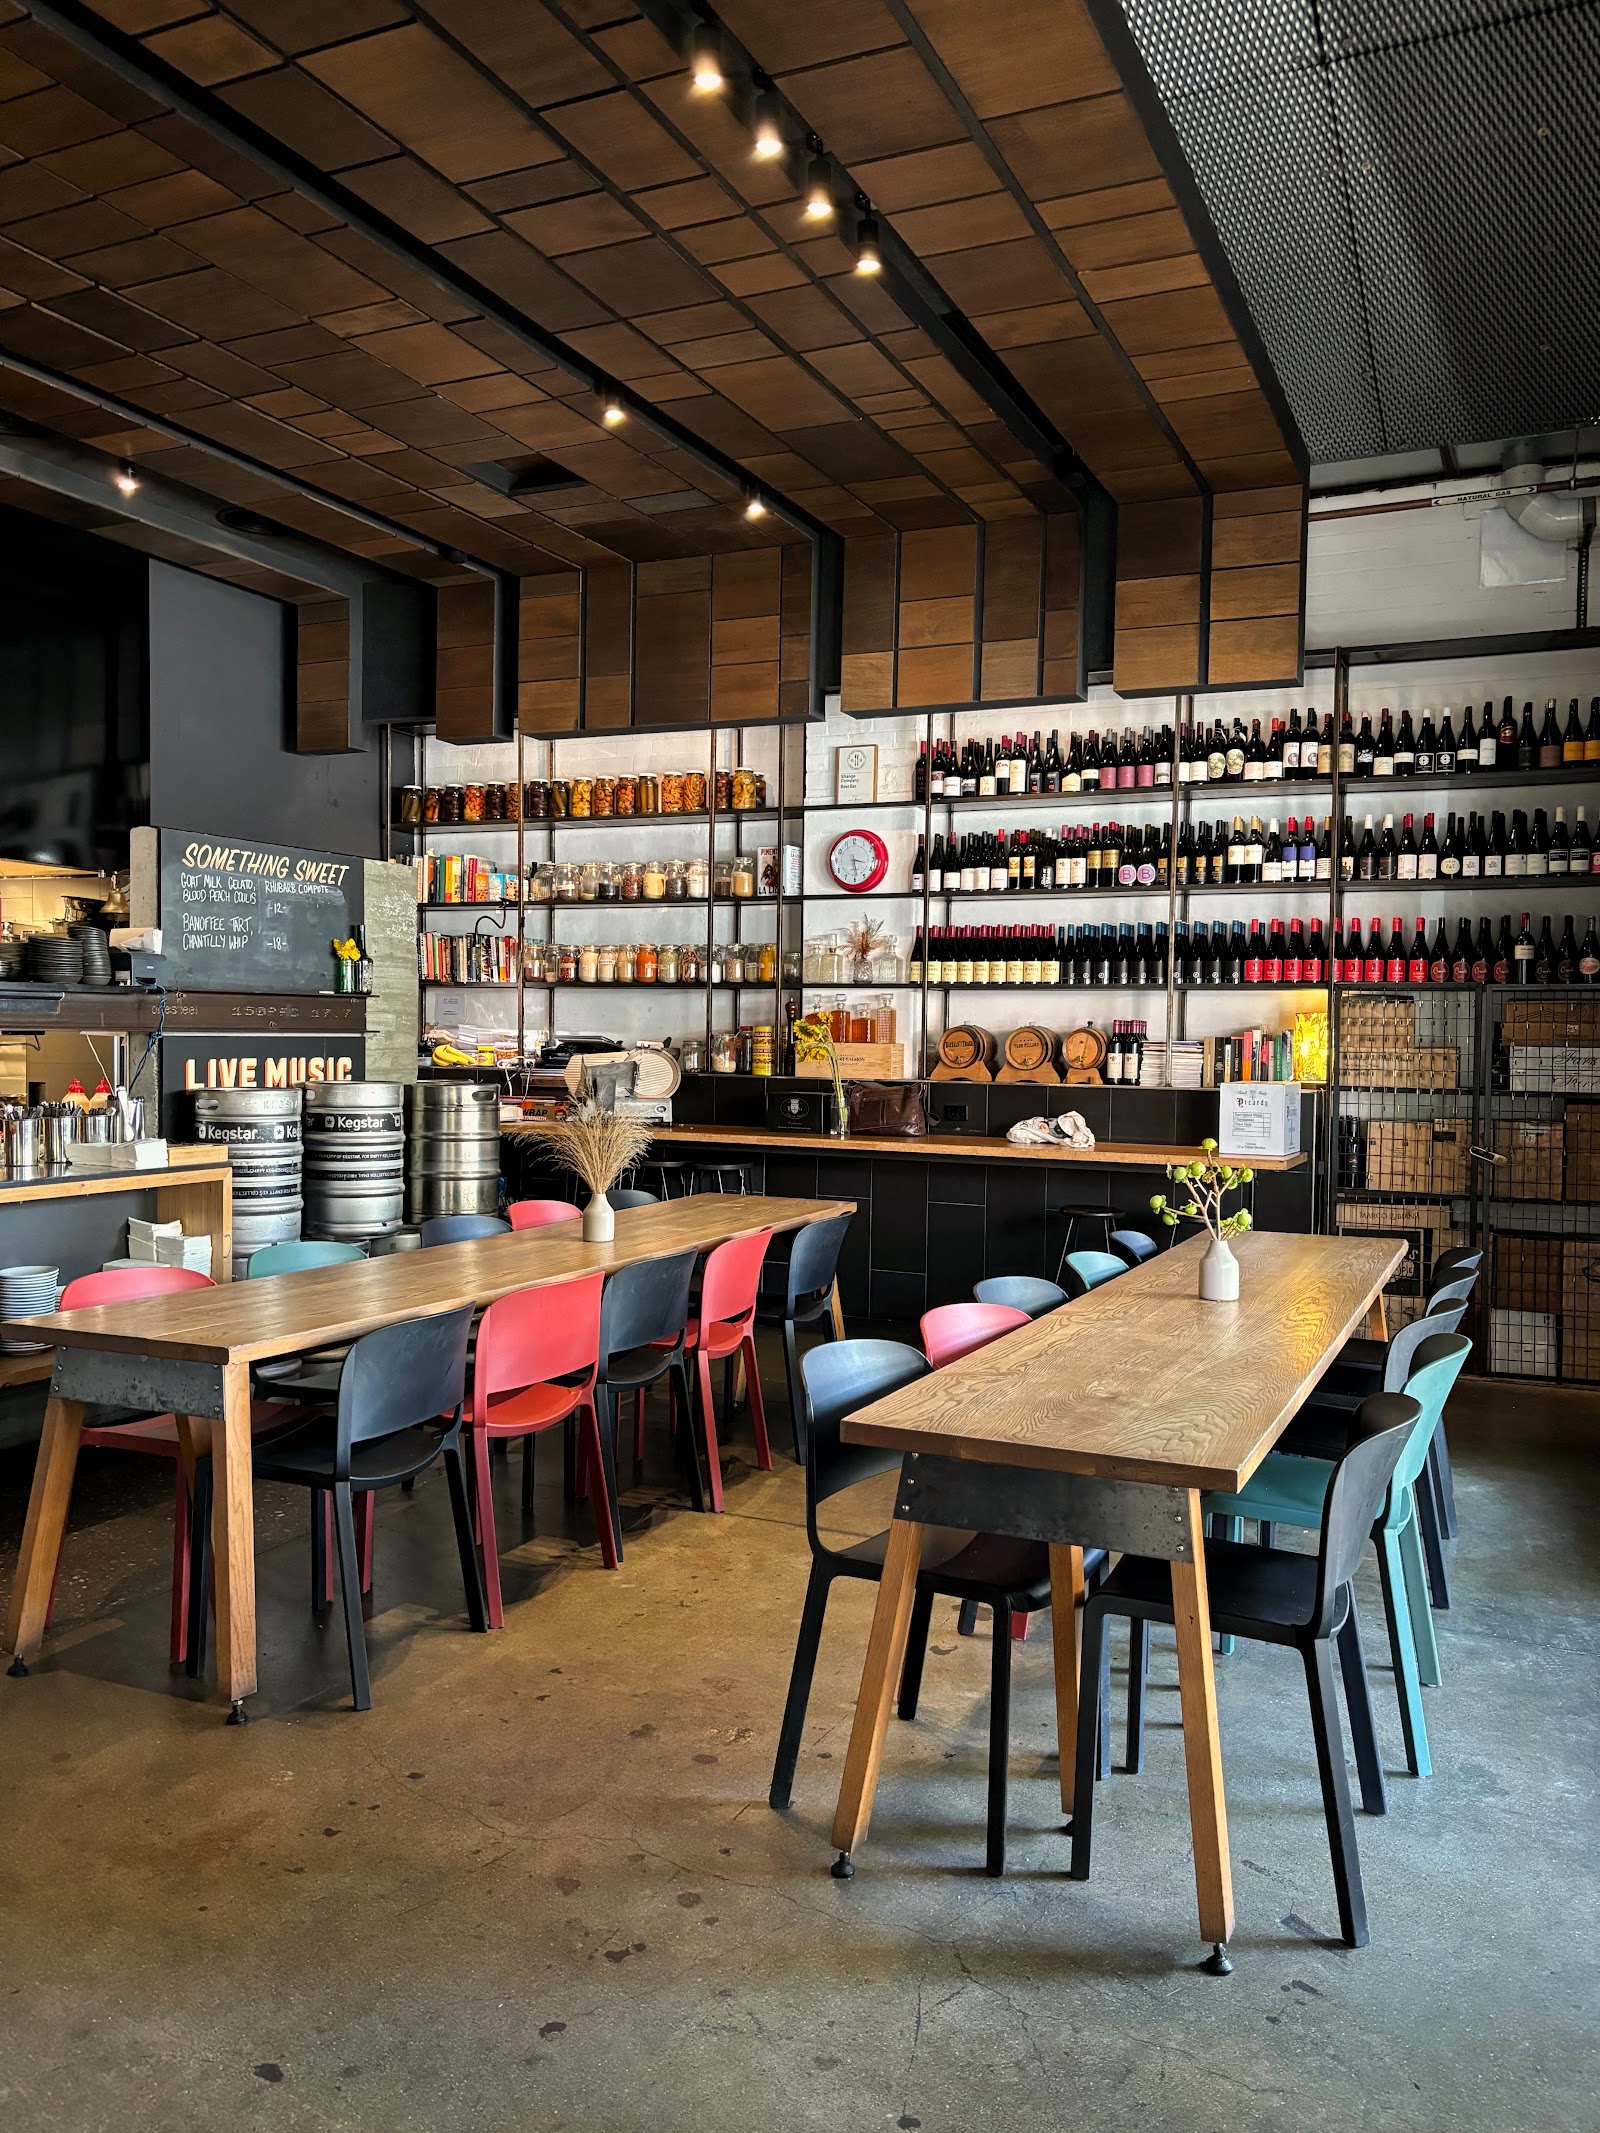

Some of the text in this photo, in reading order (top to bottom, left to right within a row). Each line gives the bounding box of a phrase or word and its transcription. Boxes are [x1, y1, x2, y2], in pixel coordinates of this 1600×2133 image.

[1457, 493, 1492, 501] NATURAL
[182, 843, 350, 886] SOMETHING SWEET
[181, 872, 256, 891] GOAT MILK GELATO,
[265, 880, 329, 894] RHUBARB COMPOTE
[183, 889, 256, 904] BLOOD PEACH COULIS
[183, 912, 253, 936] BANOFFEE TART,
[183, 933, 248, 950] CHANTILLY WHIP
[312, 1008, 351, 1018] 17.7
[185, 1057, 353, 1092] LIVE MUSIC
[338, 1116, 384, 1131] Kegstar
[208, 1124, 258, 1141] Kegstar
